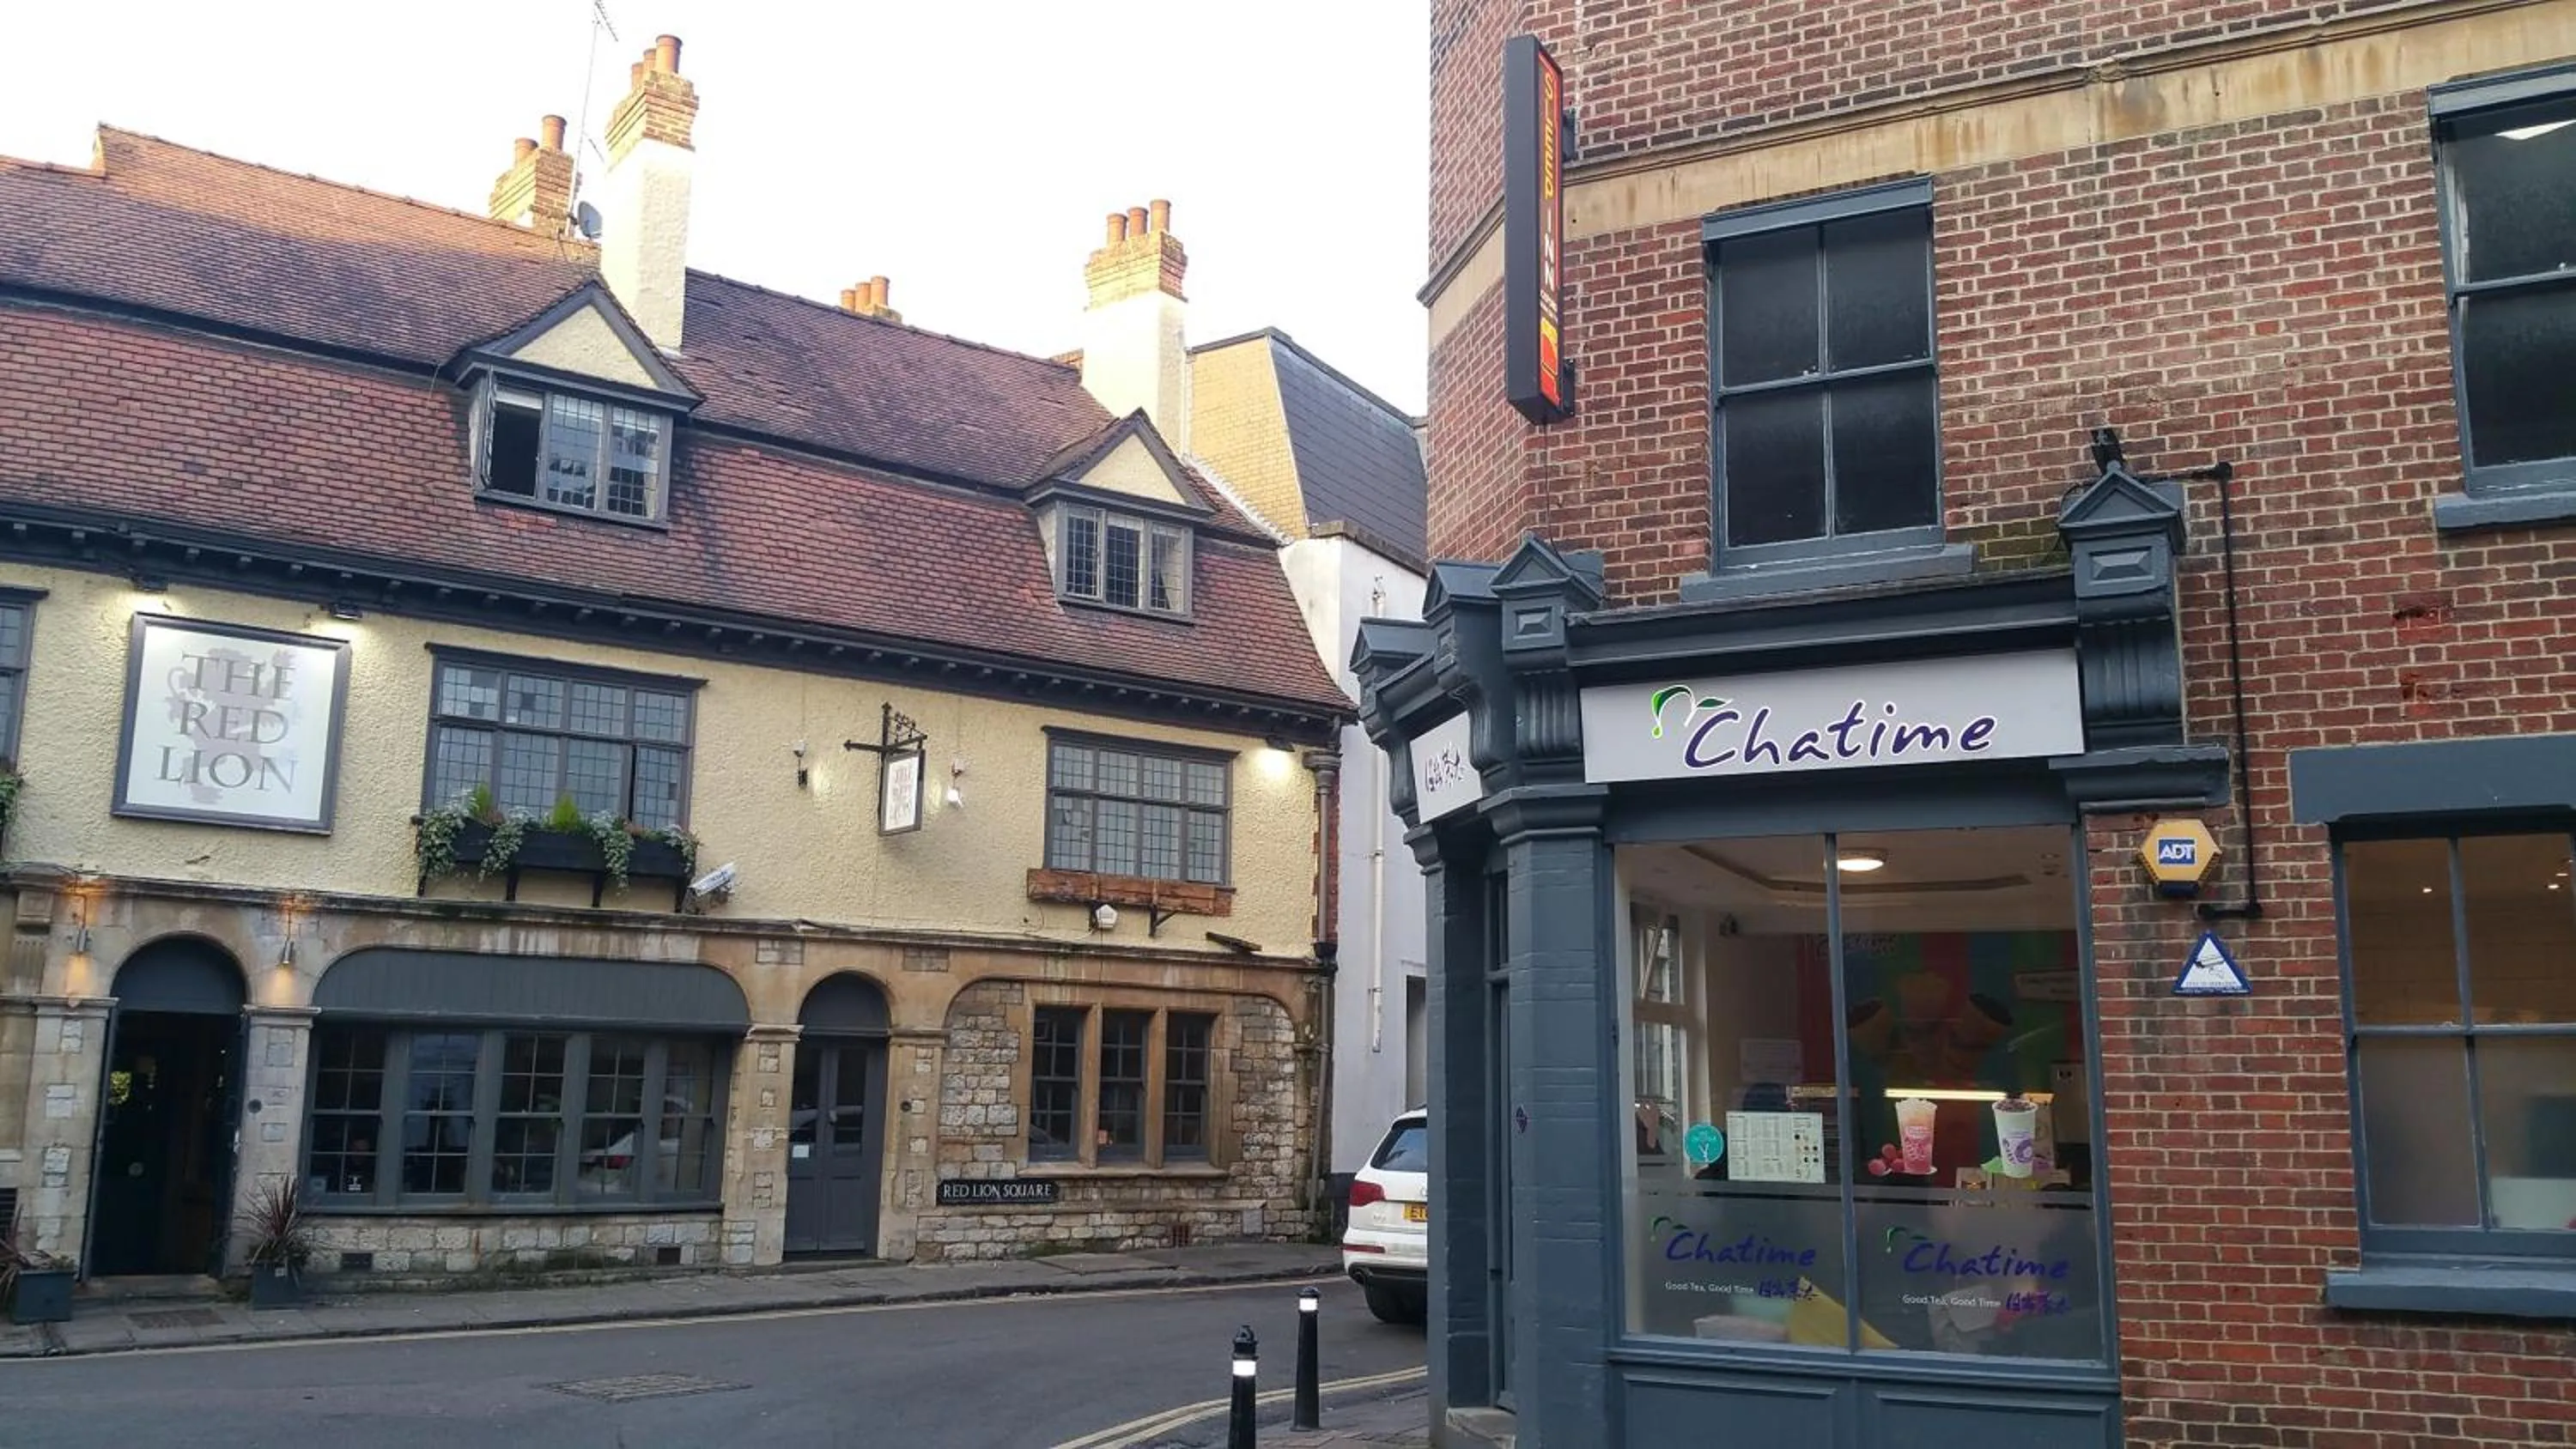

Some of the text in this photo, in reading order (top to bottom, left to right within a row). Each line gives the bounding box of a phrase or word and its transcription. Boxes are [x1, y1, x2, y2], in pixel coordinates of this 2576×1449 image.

[182, 650, 295, 700] THE
[179, 700, 289, 744] RED
[1684, 700, 1997, 769] Chatime
[156, 744, 298, 793] LION
[2159, 843, 2196, 860] ADT
[943, 1183, 1052, 1199] RED LION SQUARE
[1666, 1231, 1817, 1267] Chatime
[1902, 1241, 2069, 1279] Chatime
[1665, 1281, 1688, 1291] Good
[1708, 1283, 1732, 1294] Good
[1734, 1284, 1755, 1294] Time
[1902, 1293, 1928, 1305] Good
[1950, 1295, 1976, 1307] Good
[1978, 1297, 2002, 1308] Time
